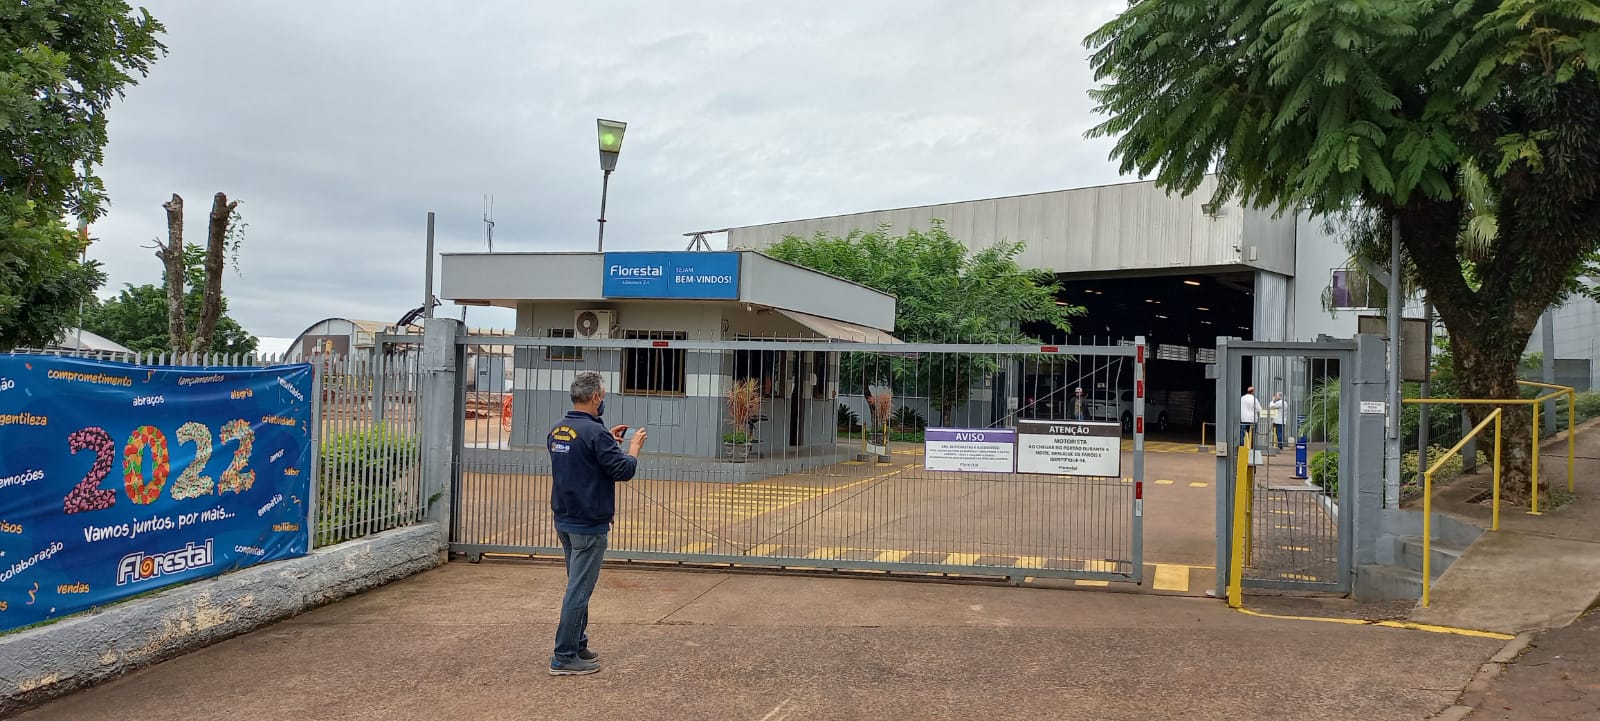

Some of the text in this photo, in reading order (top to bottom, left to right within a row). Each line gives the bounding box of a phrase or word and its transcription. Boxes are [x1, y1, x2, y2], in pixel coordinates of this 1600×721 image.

[610, 265, 662, 276] Florestal
[676, 275, 732, 284] BEM-VINDOS!
[48, 370, 132, 386] comprometimento
[178, 374, 224, 386] lançamentos
[230, 388, 253, 400] alegria
[277, 376, 304, 402] resultados
[133, 395, 164, 406] abraços
[0, 412, 47, 426] gentileza
[262, 414, 296, 426] criatividade
[956, 432, 984, 442] AVISO
[1049, 425, 1090, 435] ATENÇÃO
[270, 449, 284, 463] amor
[63, 419, 256, 515] 2022
[0, 469, 44, 488] emoções
[258, 494, 282, 516] empatia
[84, 505, 235, 542] Vamos juntos, por mais...
[0, 541, 63, 582] colaboração
[116, 538, 214, 586] Florestal
[57, 580, 90, 594] vendas
